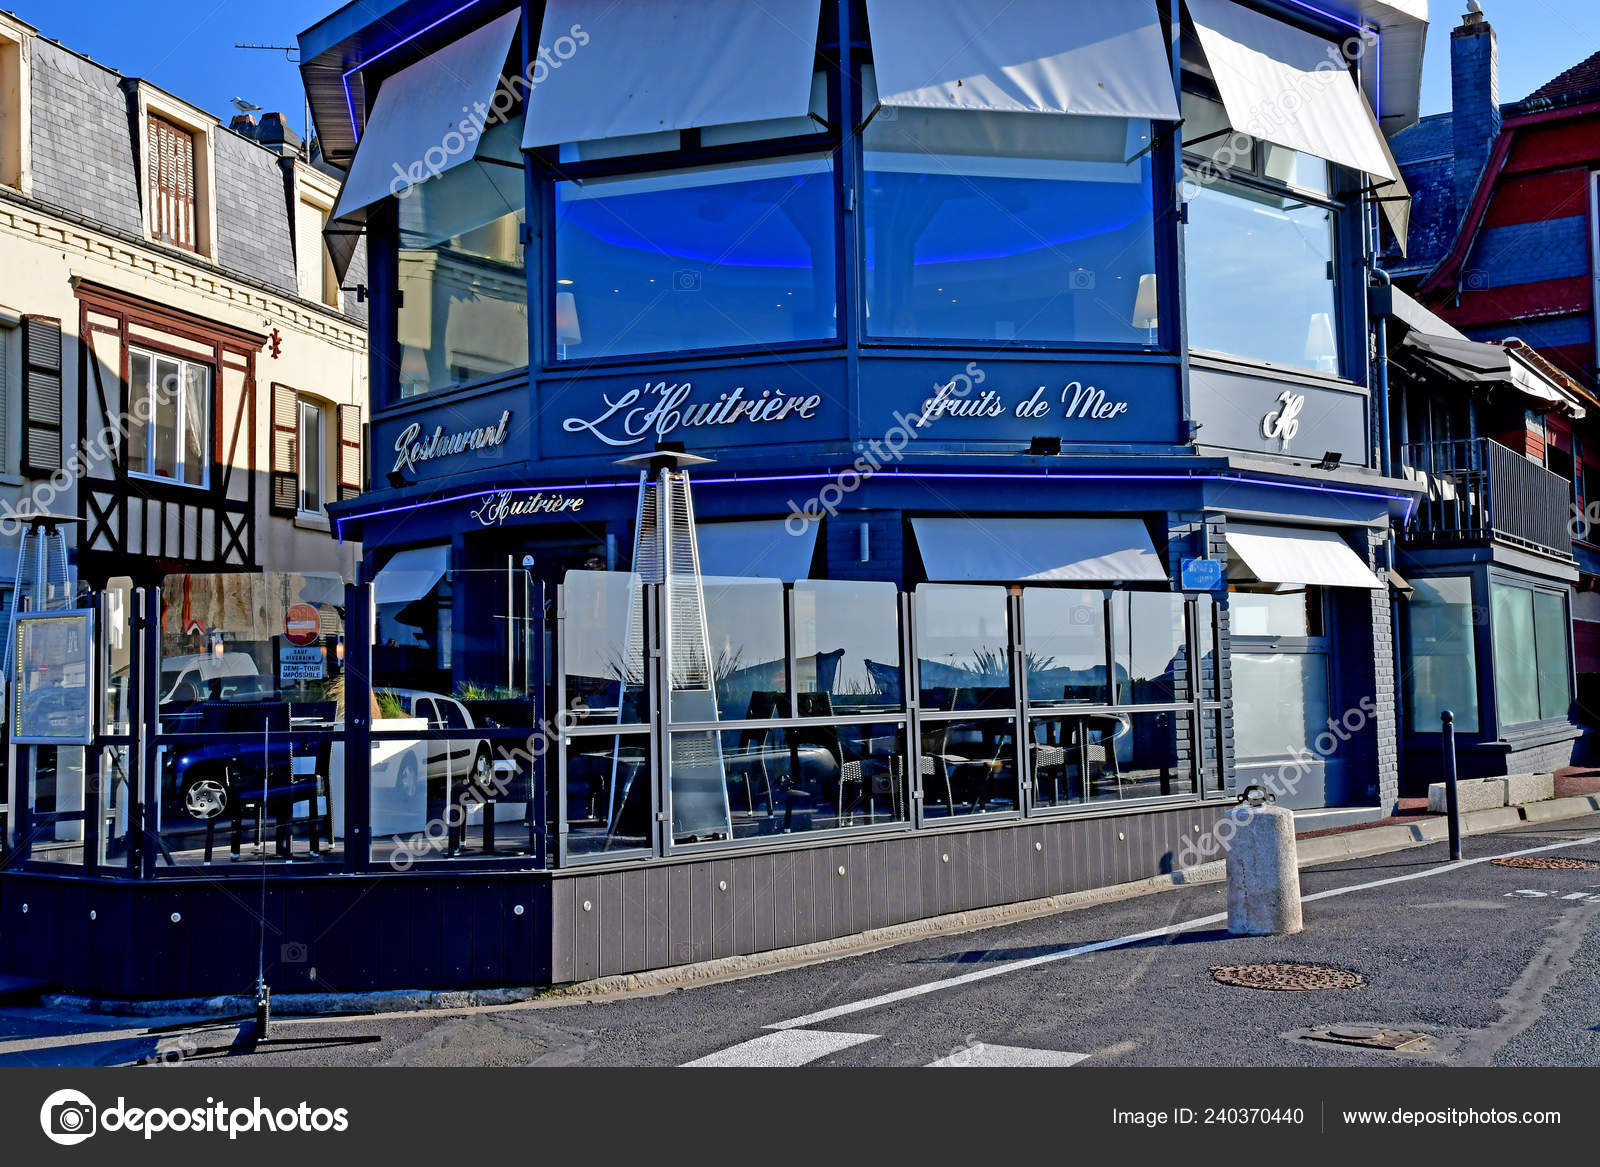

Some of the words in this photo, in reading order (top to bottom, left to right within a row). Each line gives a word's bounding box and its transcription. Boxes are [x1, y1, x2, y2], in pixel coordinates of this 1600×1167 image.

[562, 381, 821, 446] L'Huitrière
[915, 381, 1007, 428] fruits
[1015, 386, 1051, 418] de
[1061, 381, 1128, 419] Mer
[391, 409, 511, 475] Restaurant
[470, 489, 585, 526] LHuitrière
